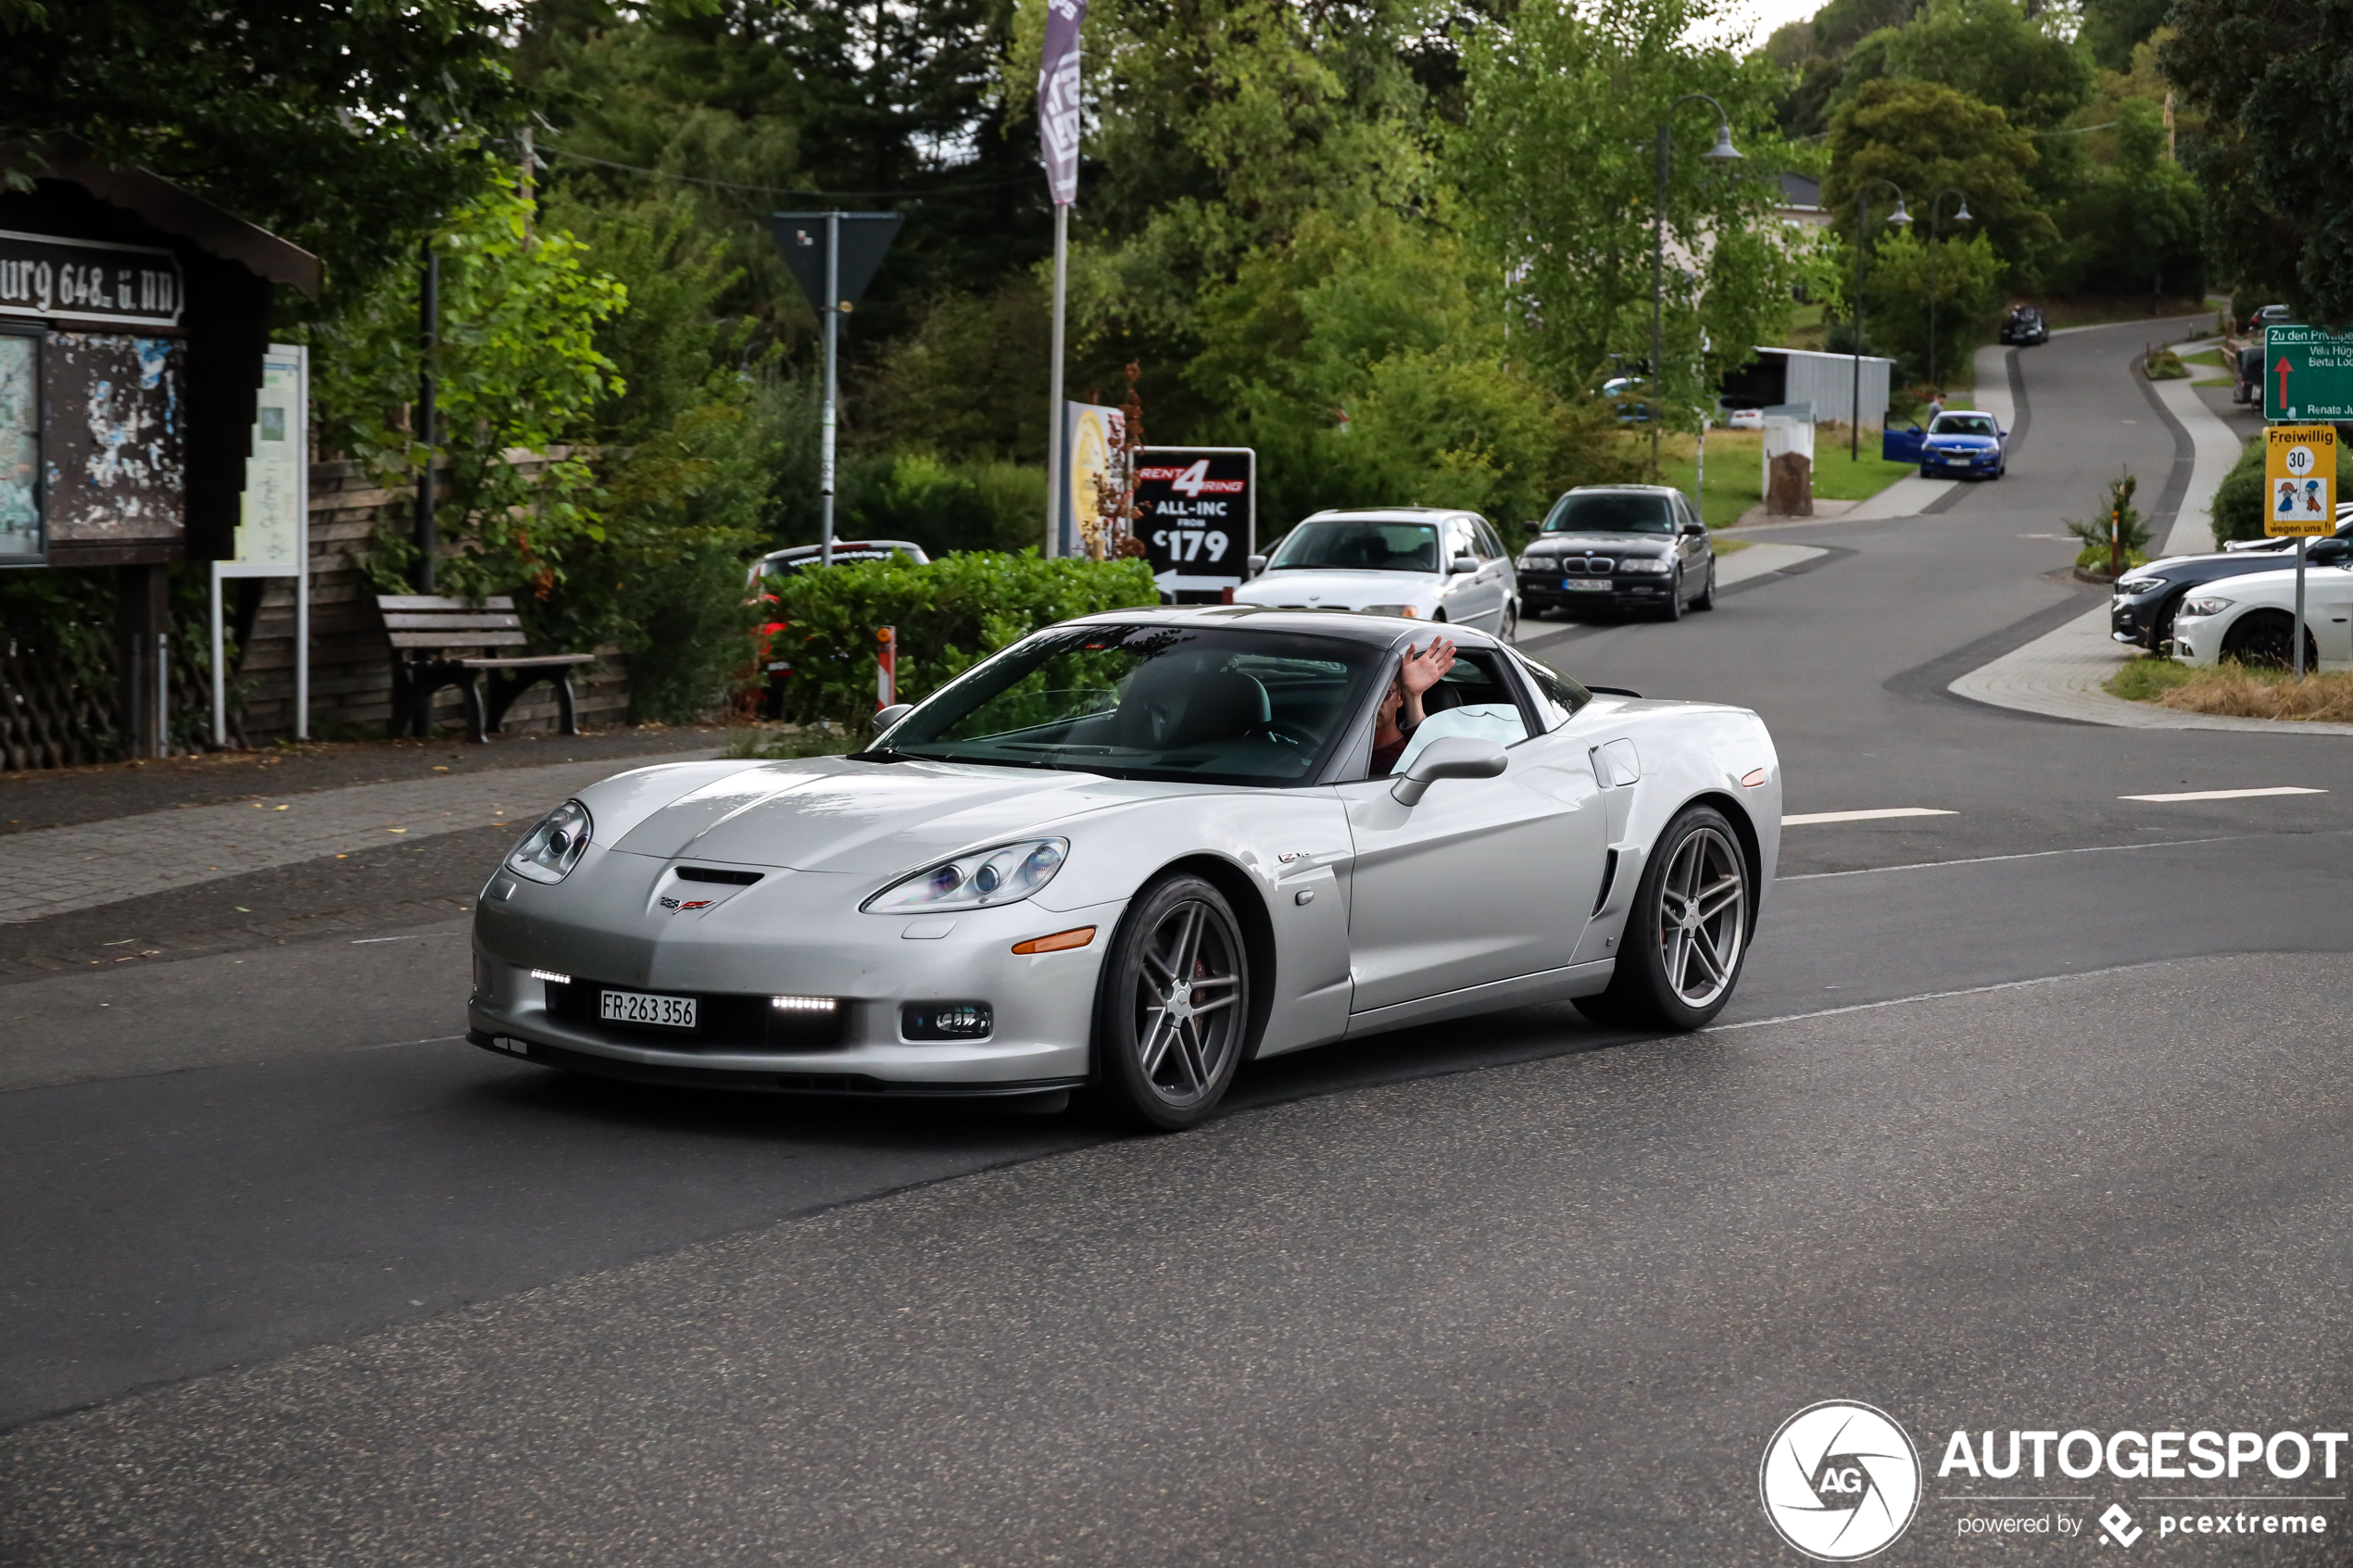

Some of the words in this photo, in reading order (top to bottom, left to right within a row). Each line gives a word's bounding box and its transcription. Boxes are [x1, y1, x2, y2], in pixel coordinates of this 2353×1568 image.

[2271, 330, 2285, 342] Zu
[2287, 330, 2308, 341] den
[2308, 404, 2342, 415] Renate
[2270, 430, 2334, 445] Freiwillig
[2289, 452, 2305, 468] 30
[1156, 500, 1228, 516] ALL-INC
[1177, 519, 1206, 527] FROM
[2270, 524, 2301, 534] wegen
[1152, 530, 1228, 562] €179
